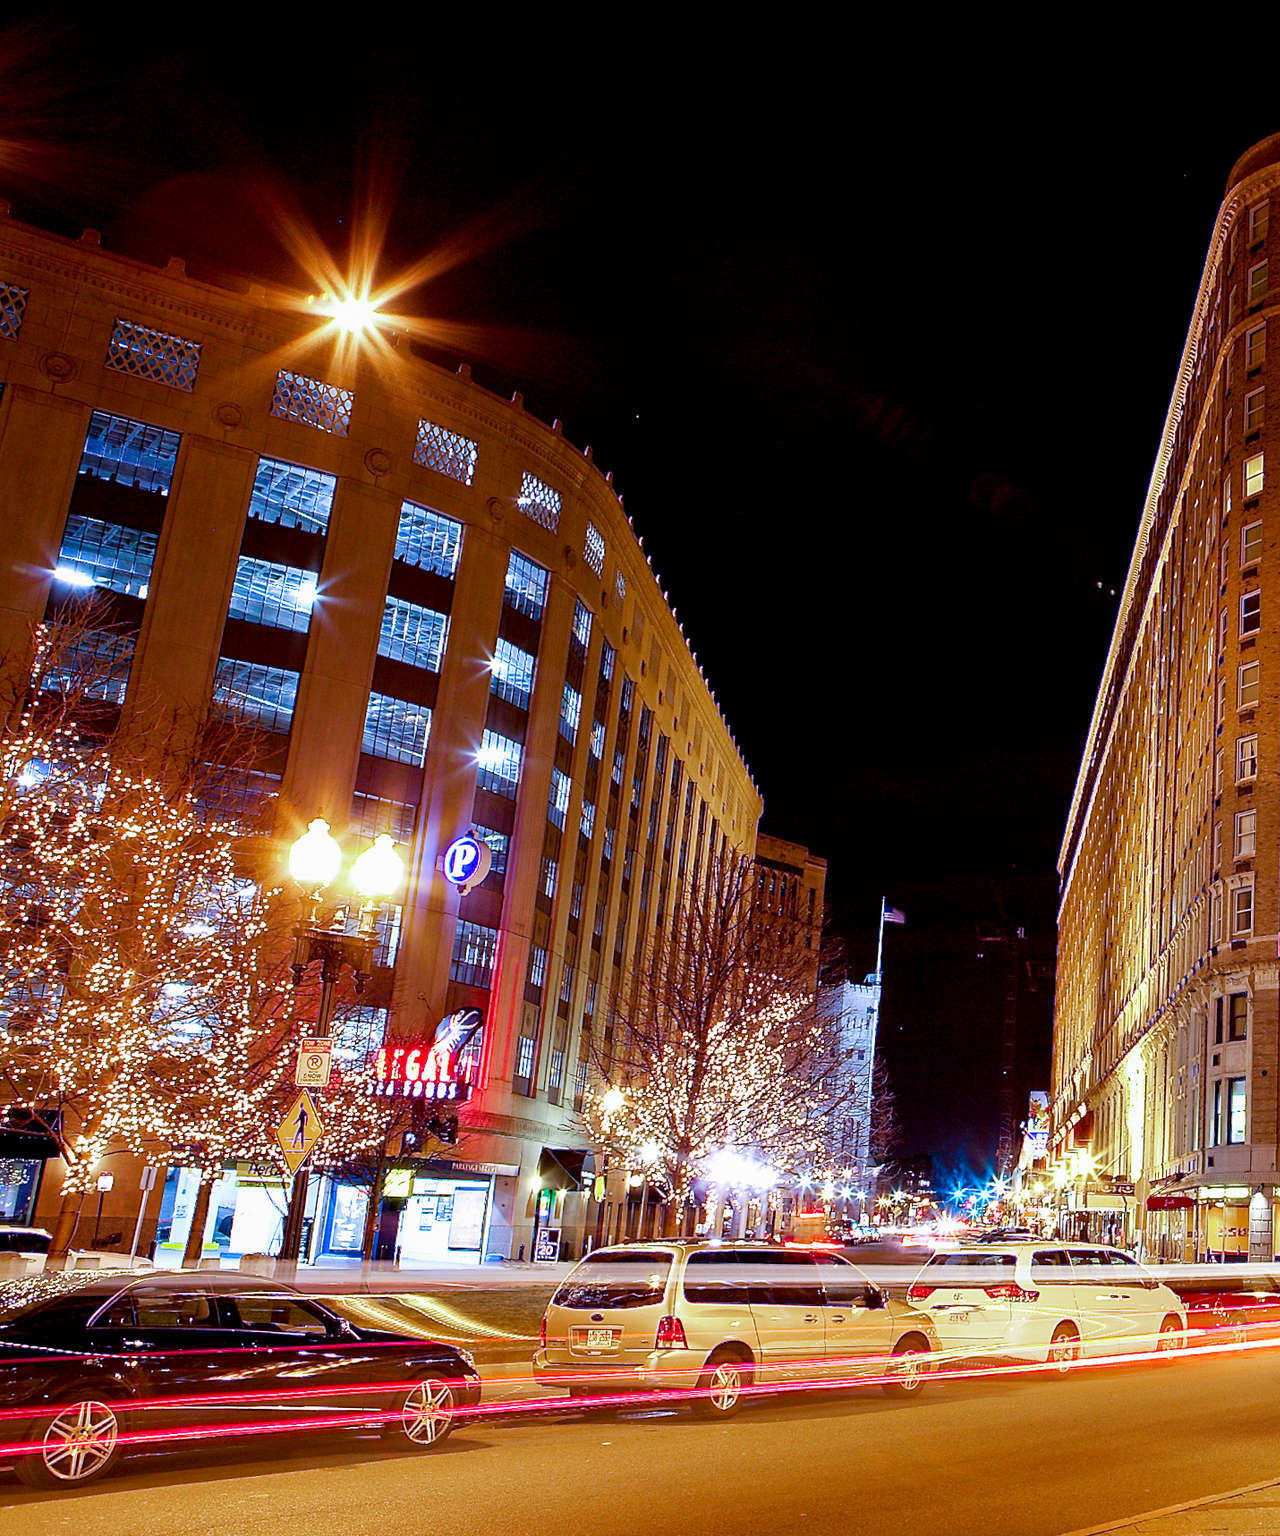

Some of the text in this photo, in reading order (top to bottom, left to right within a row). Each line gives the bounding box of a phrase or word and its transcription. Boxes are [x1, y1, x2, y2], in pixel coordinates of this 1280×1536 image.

[451, 844, 476, 877] P
[376, 1048, 451, 1082] LEGAL
[402, 1079, 458, 1099] FOODS
[248, 1162, 281, 1177] Hert
